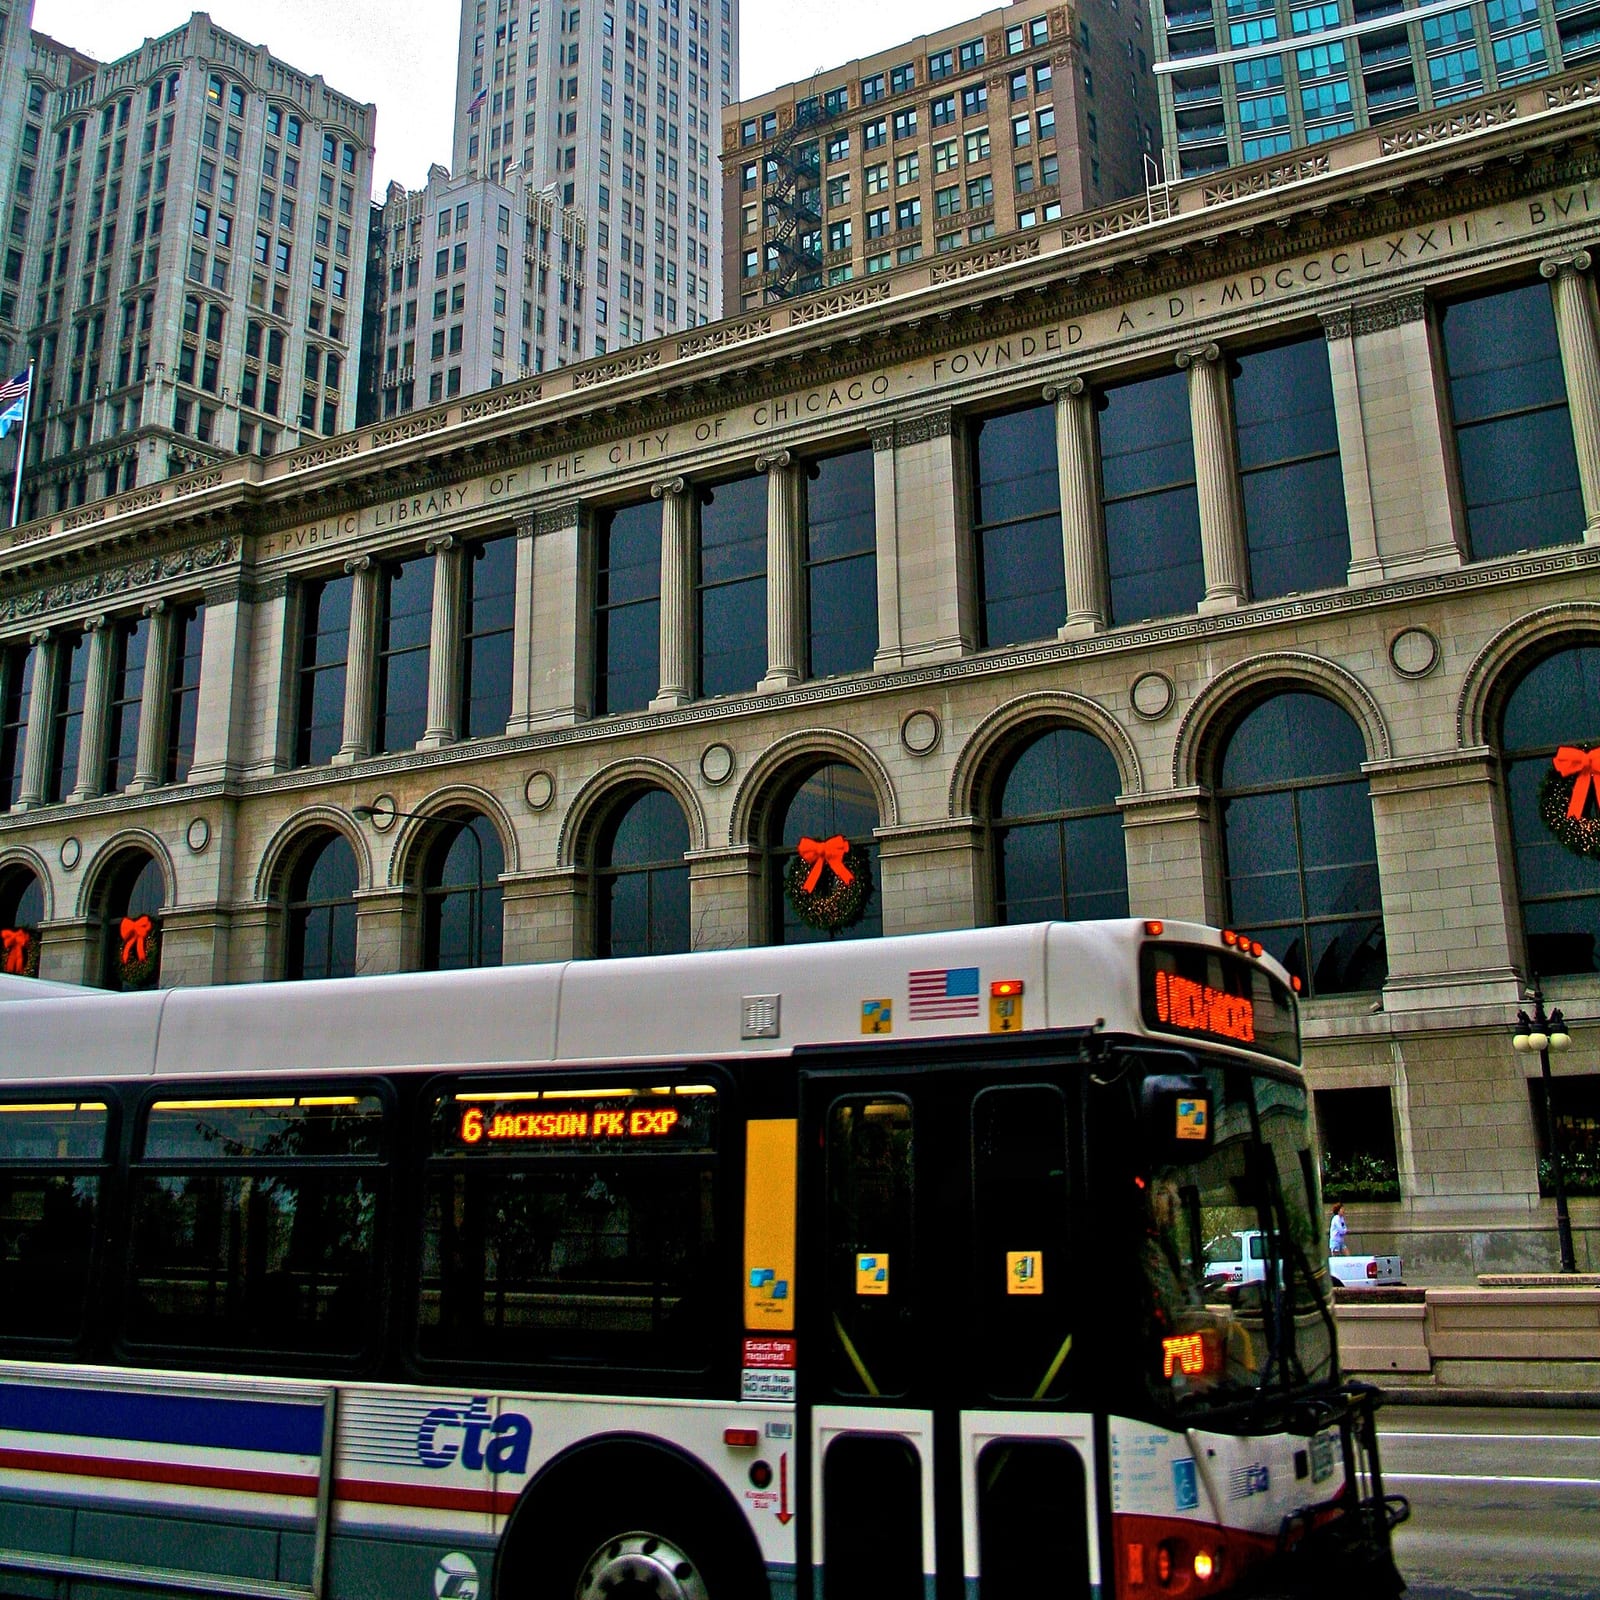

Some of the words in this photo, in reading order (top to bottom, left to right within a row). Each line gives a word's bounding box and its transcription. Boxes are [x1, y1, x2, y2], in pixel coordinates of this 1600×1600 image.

[284, 517, 355, 550] PVBLIC
[375, 486, 468, 526] LIBRARY
[490, 473, 517, 495] OF
[541, 455, 585, 482] THE
[608, 433, 668, 463] CITY
[695, 417, 726, 441] OF
[753, 375, 889, 426] CHICAGO
[934, 324, 1082, 380] FOVNDED
[462, 1108, 482, 1143] 6
[488, 1115, 587, 1137] JACKSON
[593, 1112, 625, 1134] PK
[631, 1110, 678, 1133] EXP
